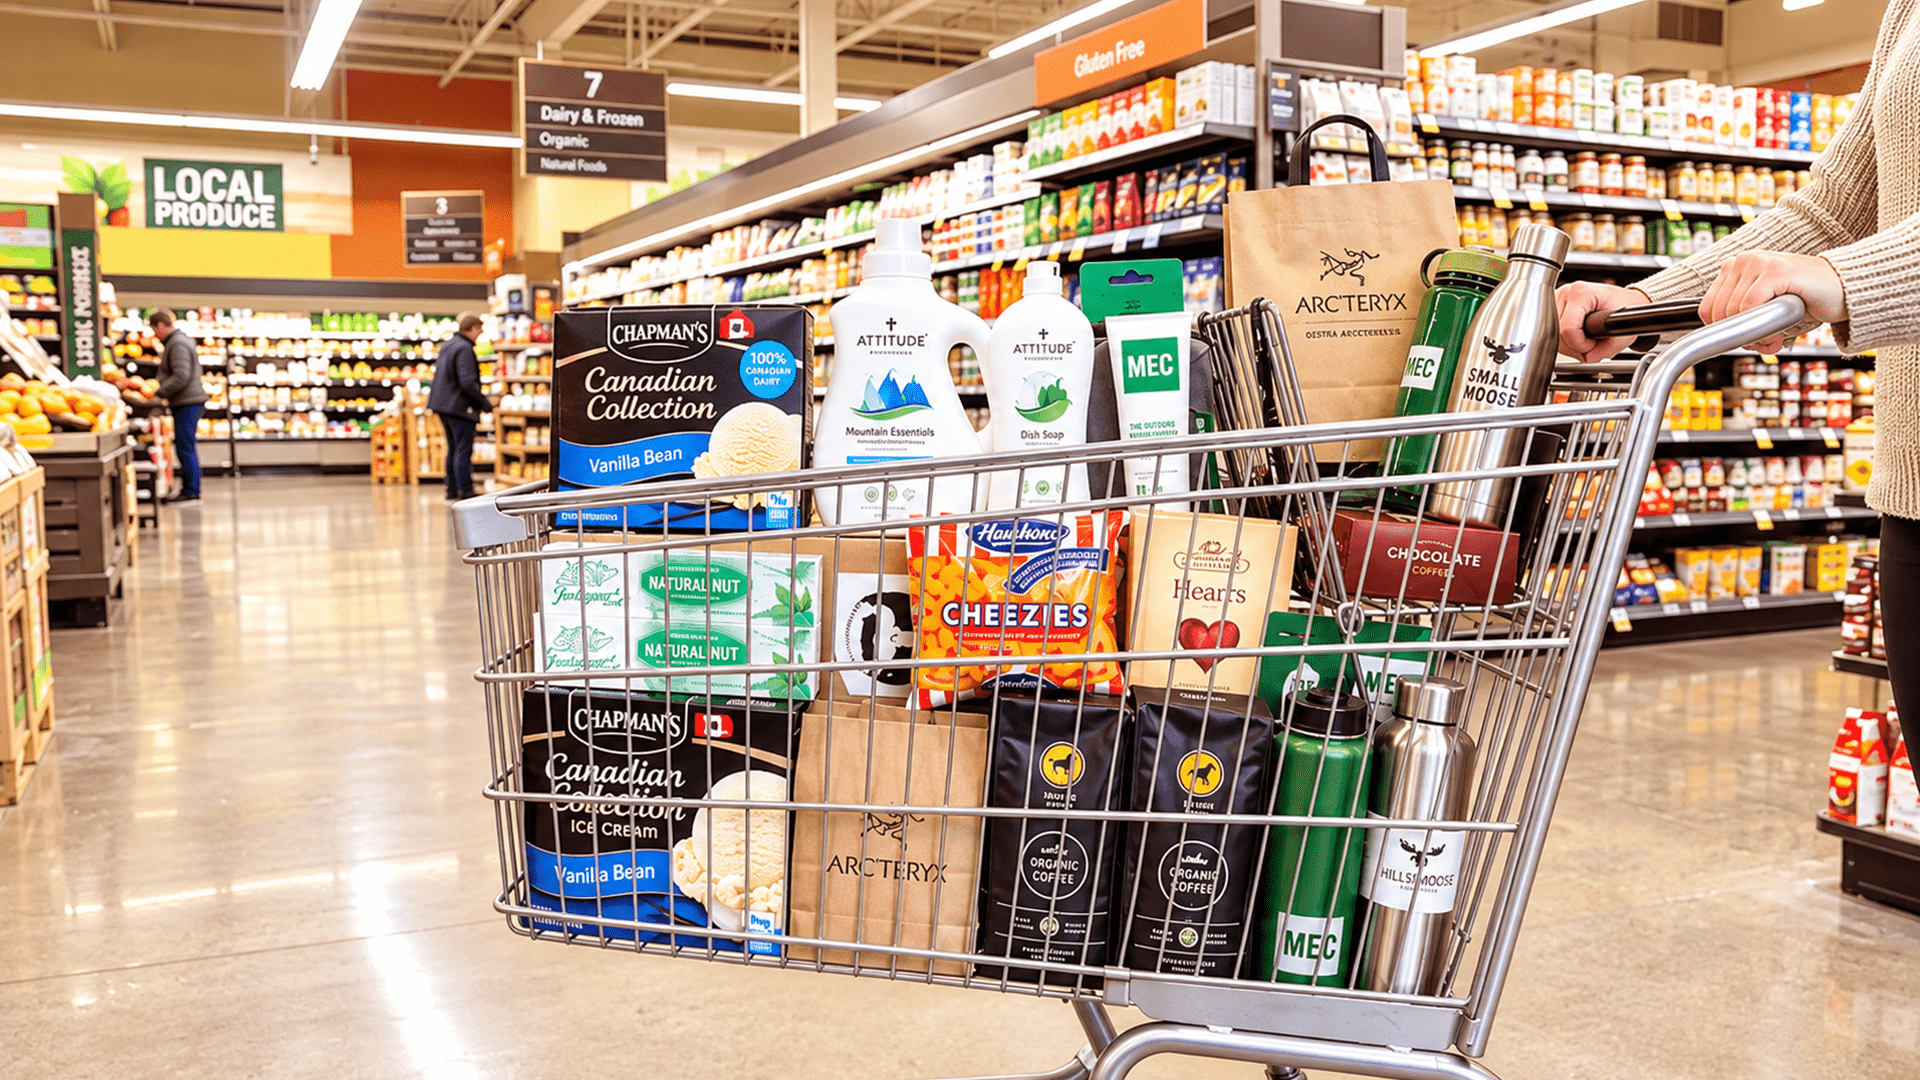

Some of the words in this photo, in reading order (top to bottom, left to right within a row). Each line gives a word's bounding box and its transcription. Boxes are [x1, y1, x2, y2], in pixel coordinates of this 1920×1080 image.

[1074, 51, 1114, 78] Gluten
[1115, 39, 1145, 65] Free
[583, 70, 603, 98] 7
[540, 105, 579, 126] Dairy
[581, 107, 594, 124] &
[597, 109, 644, 127] Frozen
[539, 131, 589, 149] Organic
[540, 157, 576, 171] Natural
[153, 165, 276, 204] LOCAL
[154, 200, 277, 229] PRODUCE
[1295, 293, 1407, 314] ARC'TERYX
[612, 321, 709, 344] CHAPMAN'S
[856, 334, 926, 347] ATTITUDE
[750, 352, 788, 365] 100%
[1012, 343, 1074, 354] ATTITUDE
[1127, 353, 1174, 378] MEC
[1404, 356, 1436, 379] MEC
[584, 366, 717, 393] Canadian
[1468, 367, 1519, 392] SMALL
[1462, 384, 1518, 408] MOOSE
[586, 395, 717, 421] Collection
[845, 426, 888, 437] Mountain
[1020, 430, 1040, 440] Dish
[1042, 430, 1065, 441] Soap
[589, 454, 641, 474] Vanilla
[643, 447, 683, 464] Bean
[1386, 546, 1482, 568] CHOCOLATE
[648, 575, 708, 592] NATURAL
[711, 577, 741, 594] NUT
[1172, 578, 1247, 604] Hearts
[942, 602, 1089, 628] CHEEZIES
[709, 645, 740, 661] NUT
[574, 708, 681, 738] CHAPMAN'S
[544, 752, 686, 788] Canadian
[571, 819, 595, 835] ICE
[554, 865, 609, 884] Vanila
[613, 864, 655, 881] Bean
[826, 855, 948, 883] ARC'TERYX
[1032, 870, 1075, 885] COFEE
[1283, 930, 1338, 960] MEC
